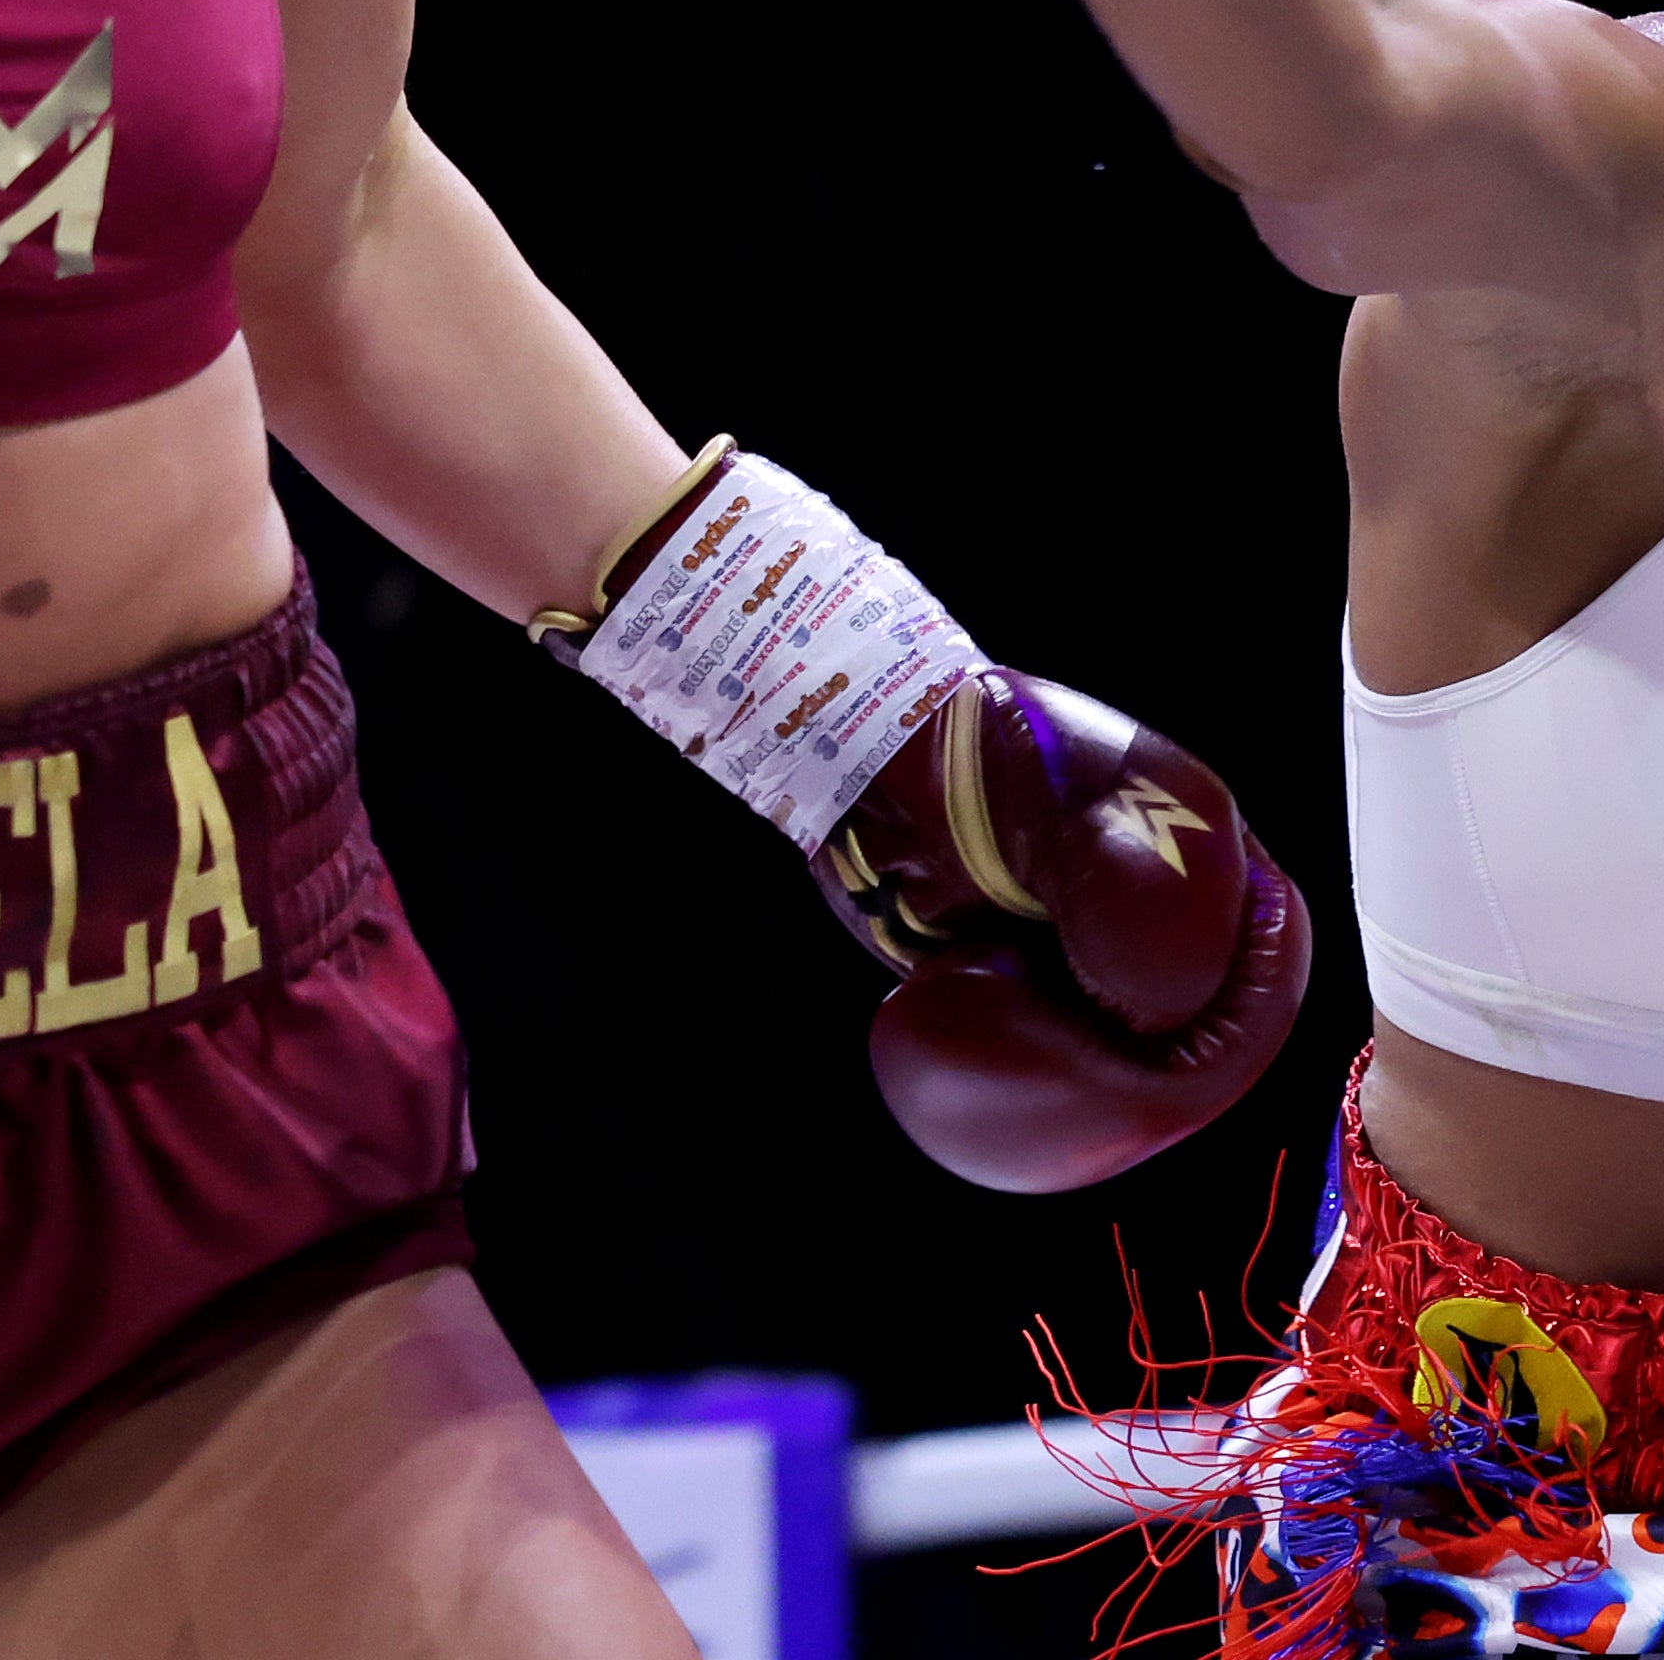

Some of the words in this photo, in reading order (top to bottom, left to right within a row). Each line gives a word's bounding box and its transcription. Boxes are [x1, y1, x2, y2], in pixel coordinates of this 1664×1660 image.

[778, 581, 822, 634] BRITISH
[779, 574, 813, 611] BOARD
[768, 609, 783, 626] OF
[677, 610, 748, 697] protape
[731, 625, 769, 670] CONTROL
[740, 632, 781, 684] BOXING
[836, 696, 882, 745] BOXING
